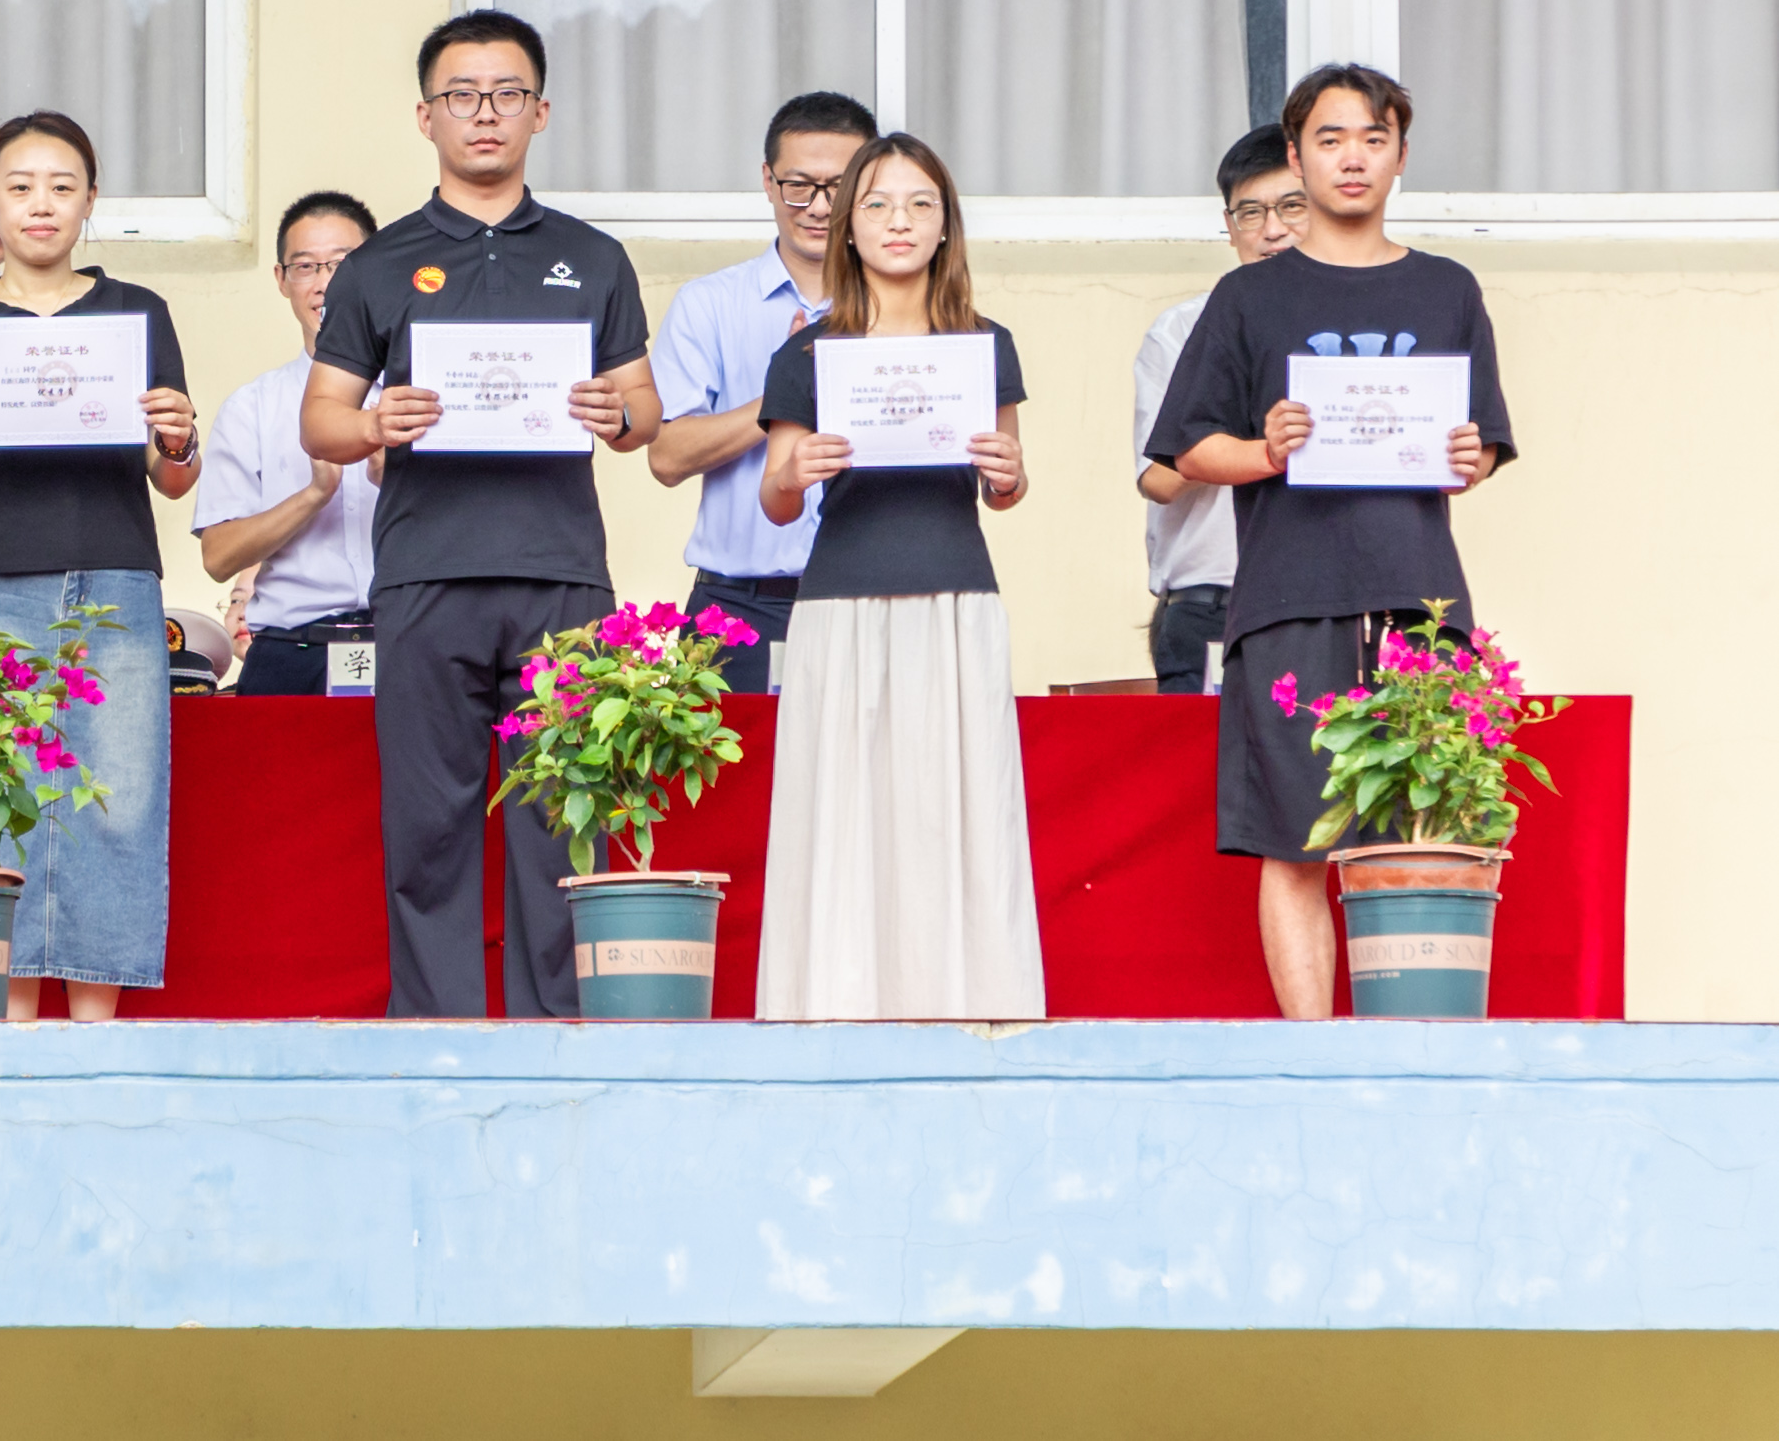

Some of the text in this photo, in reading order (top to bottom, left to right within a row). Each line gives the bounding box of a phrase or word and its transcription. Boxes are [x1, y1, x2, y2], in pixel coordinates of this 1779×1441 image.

[25, 345, 89, 357] 荣誉证书
[469, 351, 533, 362] 荣誉证书
[874, 364, 937, 375] 荣誉证书
[1345, 384, 1410, 395] 荣誉证书
[344, 649, 371, 679] 学
